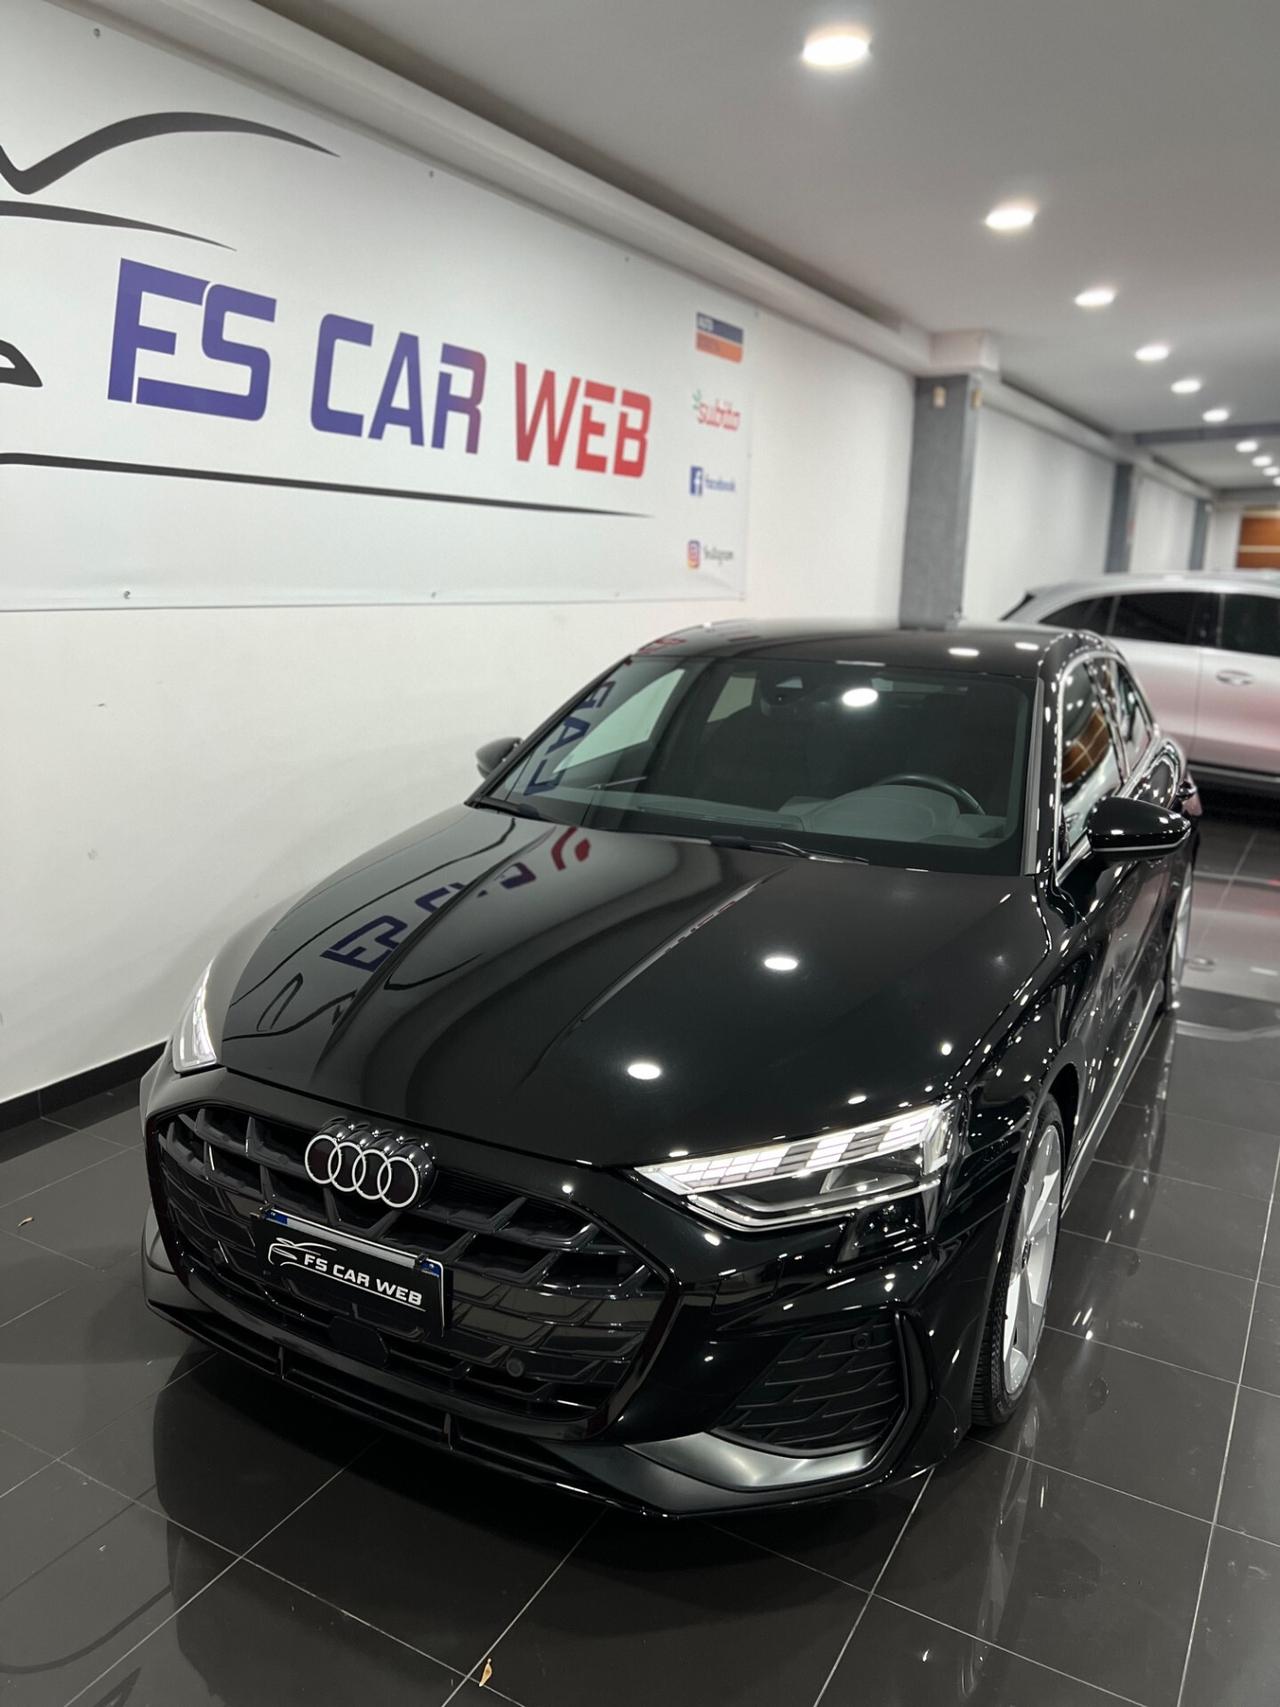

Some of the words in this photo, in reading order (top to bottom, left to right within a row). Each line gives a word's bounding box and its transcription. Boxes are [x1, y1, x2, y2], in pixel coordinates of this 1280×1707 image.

[107, 258, 277, 421] FS
[310, 313, 487, 454] CAR
[515, 362, 652, 478] WEB
[304, 1254, 328, 1272] FS
[333, 1264, 370, 1287] CAR
[376, 1278, 422, 1306] WEB
